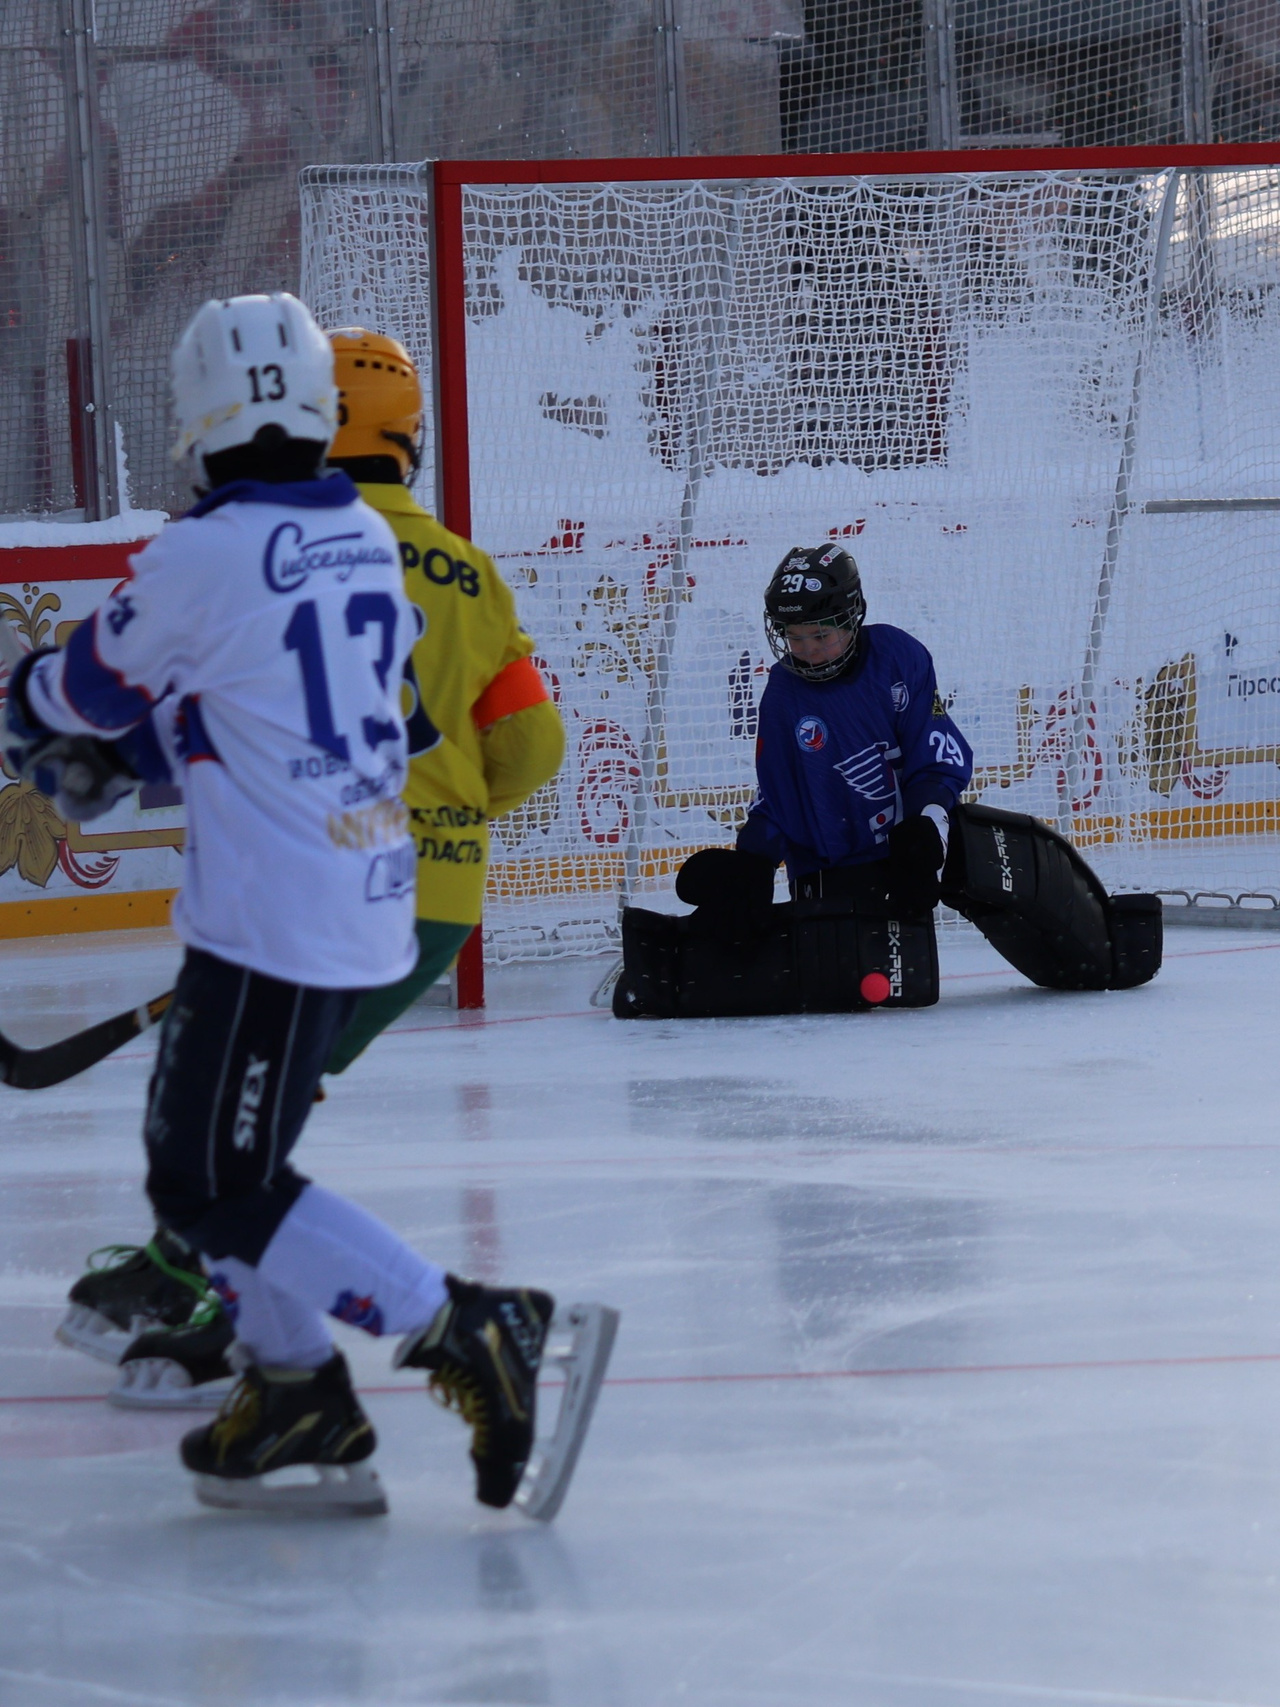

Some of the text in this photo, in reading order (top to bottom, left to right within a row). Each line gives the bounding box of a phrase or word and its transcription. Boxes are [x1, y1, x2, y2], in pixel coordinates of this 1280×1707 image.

[247, 363, 286, 403] 13
[398, 541, 481, 597] РОВ
[781, 573, 804, 593] 29
[778, 604, 803, 613] Reebok
[929, 730, 964, 767] 29
[412, 836, 482, 864] ЛАСТЬ
